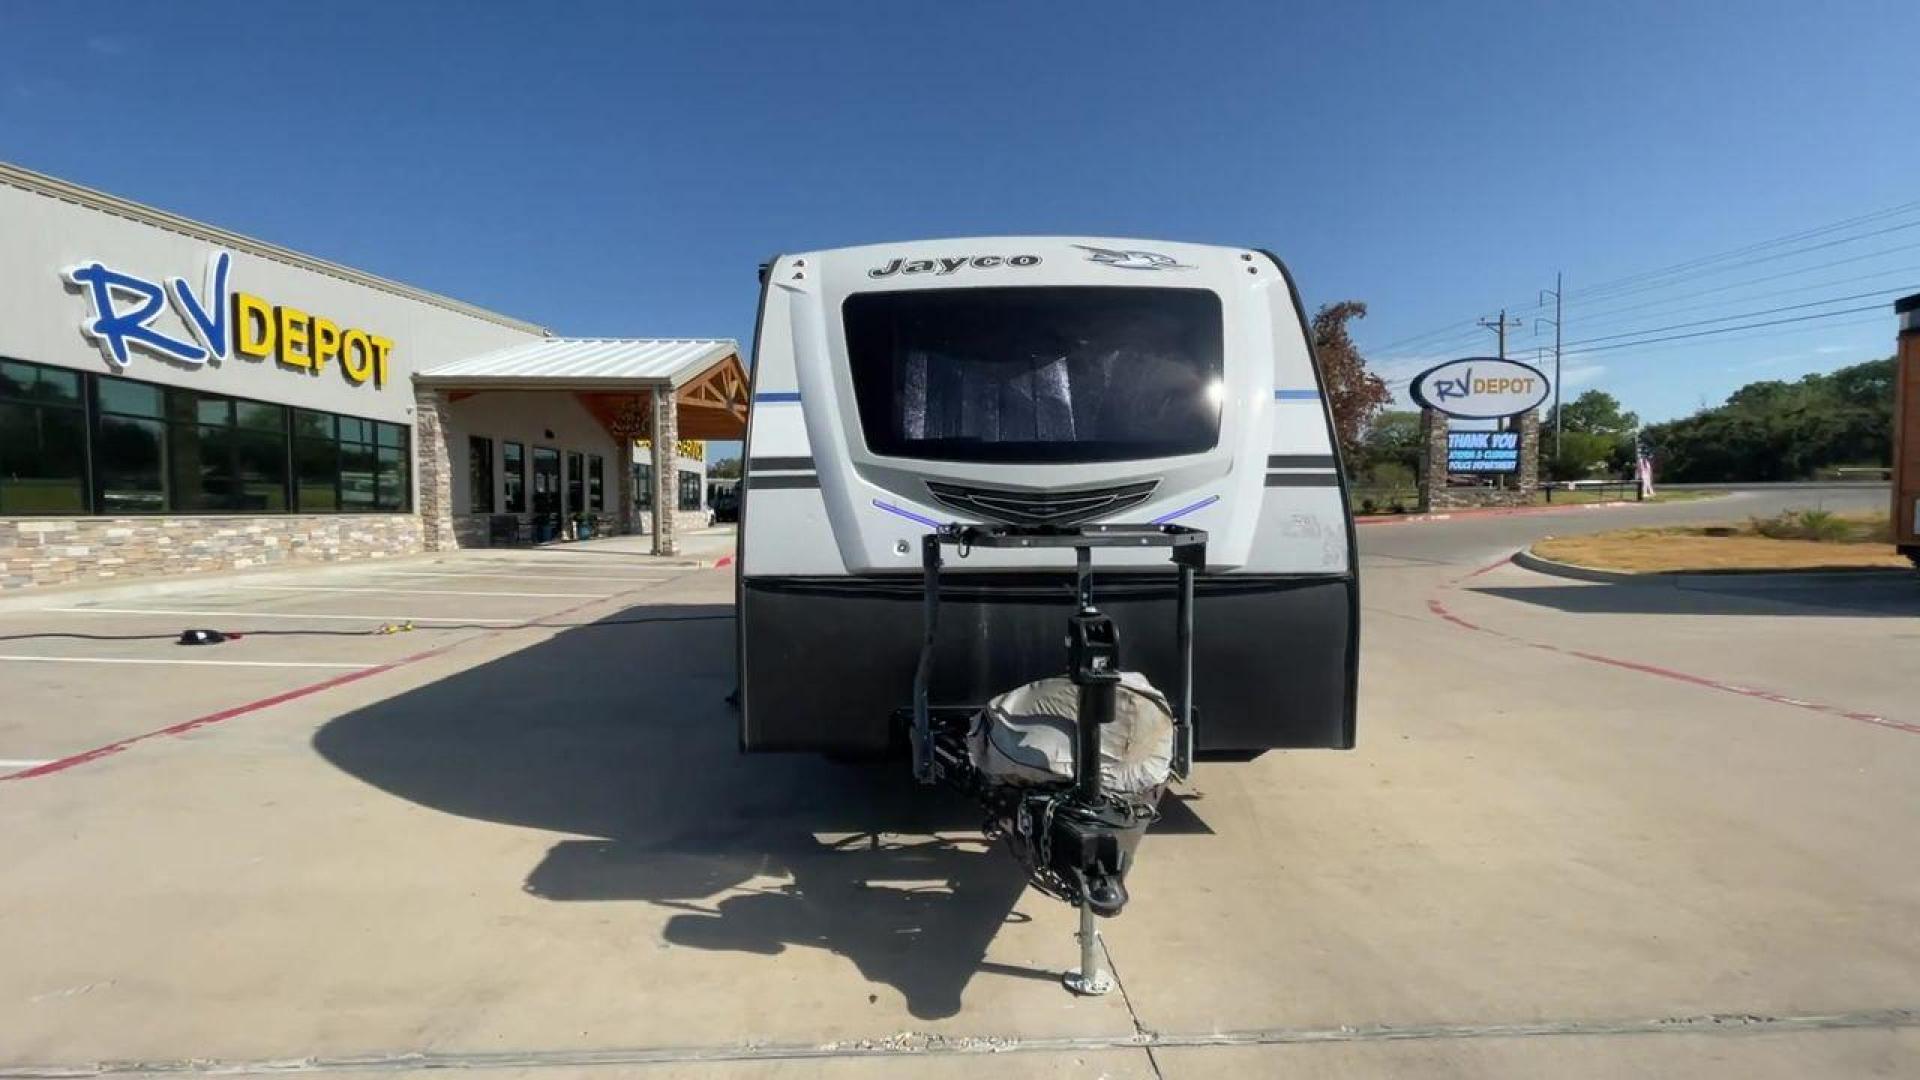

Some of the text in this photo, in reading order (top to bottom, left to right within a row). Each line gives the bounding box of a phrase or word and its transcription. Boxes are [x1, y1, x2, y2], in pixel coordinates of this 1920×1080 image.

[868, 255, 1043, 279] Jayco
[67, 250, 394, 387] RV DEPOT
[1473, 378, 1535, 394] DEPOT
[1448, 433, 1518, 448] THANK YOU
